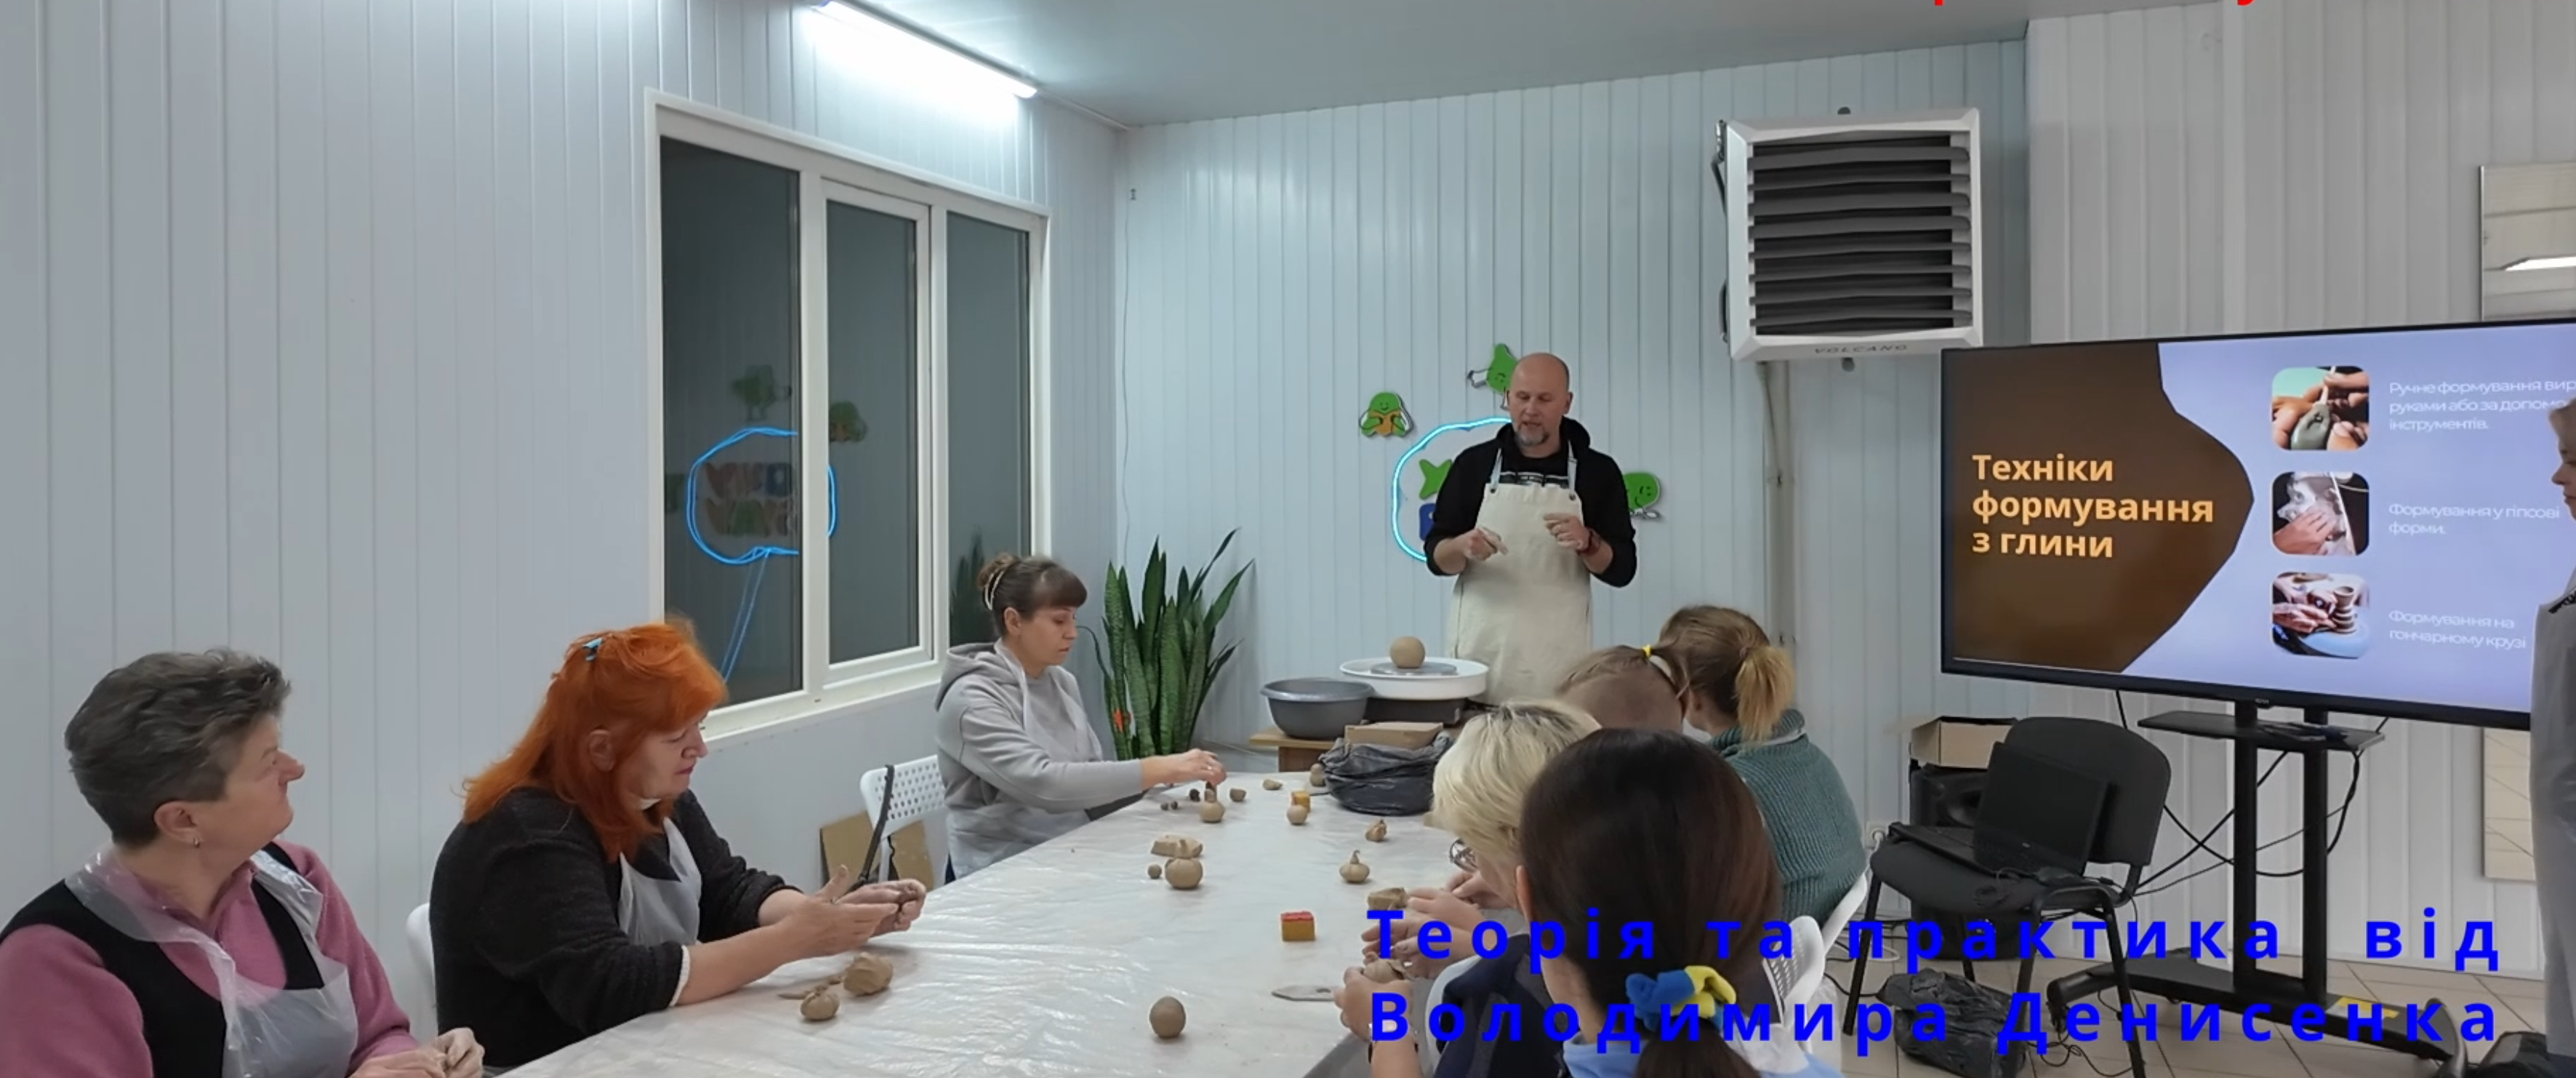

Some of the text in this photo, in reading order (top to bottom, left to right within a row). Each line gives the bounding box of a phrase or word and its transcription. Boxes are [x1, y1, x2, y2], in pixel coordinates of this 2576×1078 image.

[1815, 345, 1906, 354] VOLCANO
[2389, 382, 2436, 396] Ручне
[2437, 380, 2542, 395] формування
[2389, 401, 2447, 415] руками
[2448, 399, 2479, 412] або
[2480, 400, 2499, 411] за
[1973, 453, 2113, 482] Техніки
[1973, 489, 2214, 527] формування
[2388, 503, 2560, 519] Формування у гіпсові
[1973, 532, 2113, 558] з глини
[2388, 610, 2514, 629] Формування на
[2389, 630, 2527, 650] гончарному крузі
